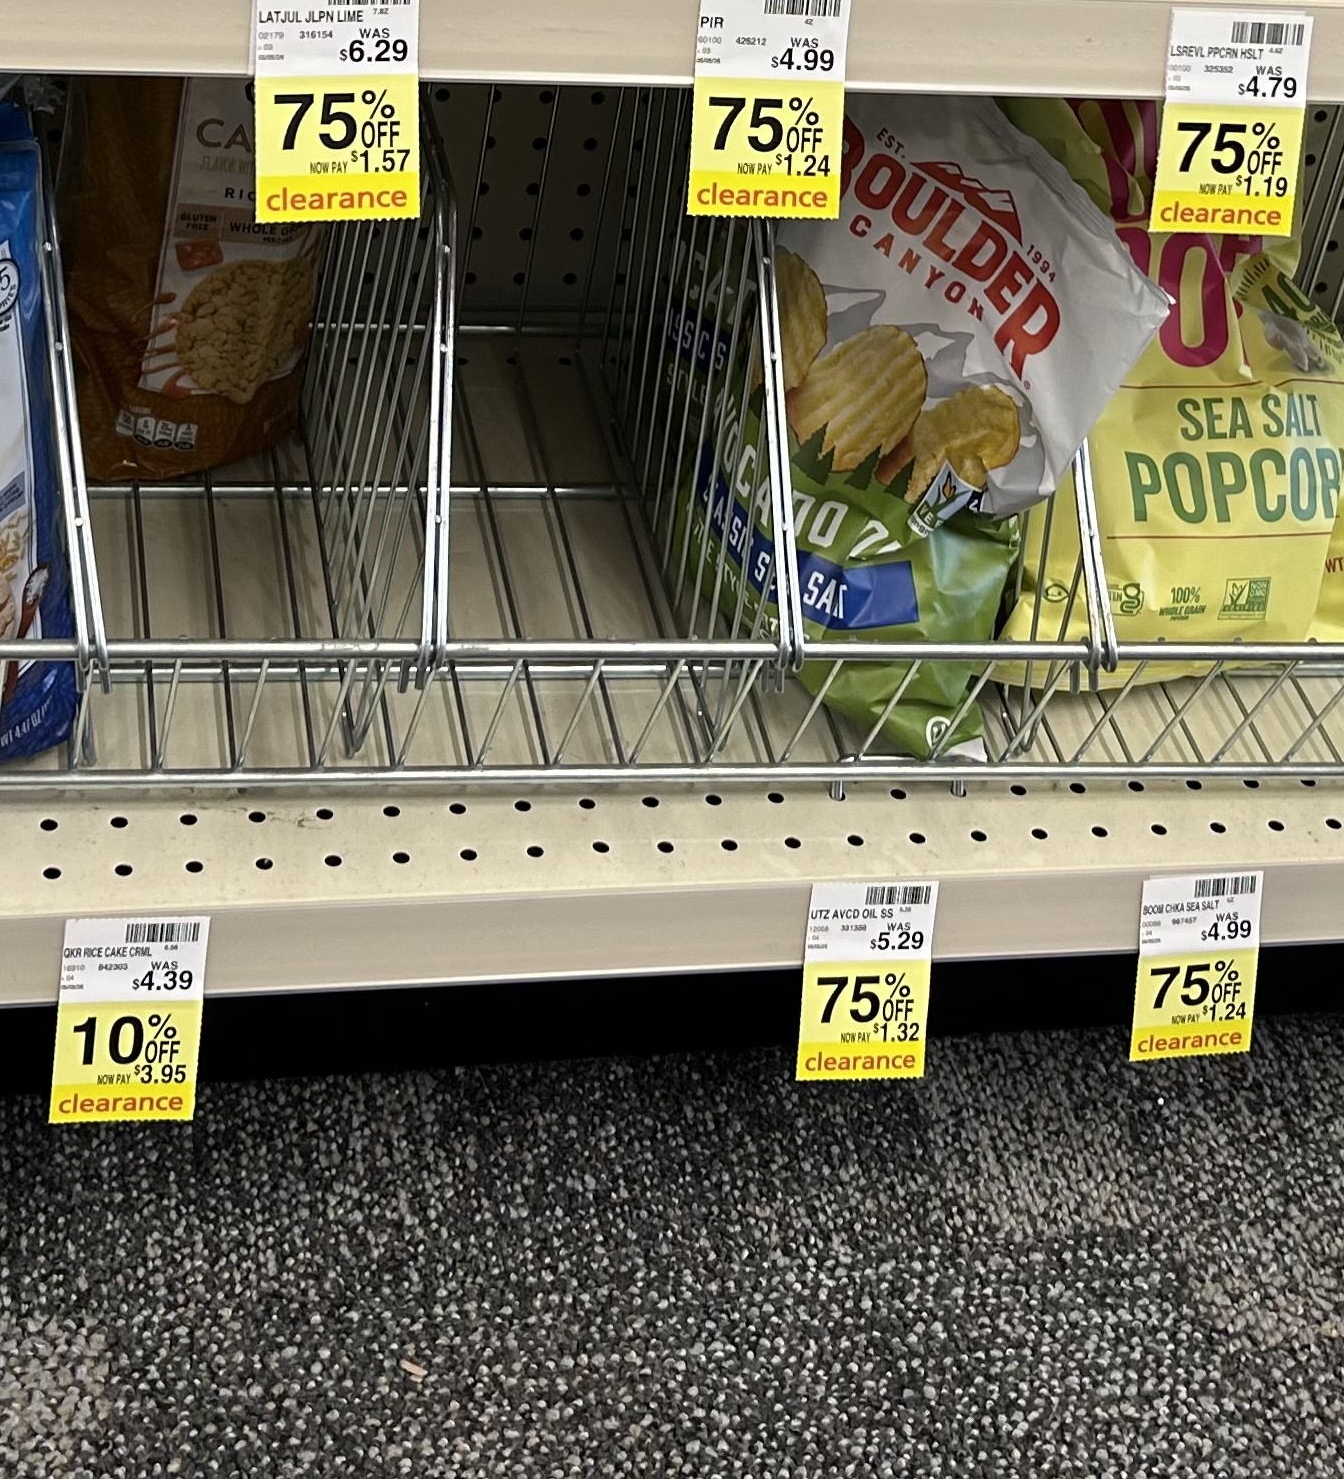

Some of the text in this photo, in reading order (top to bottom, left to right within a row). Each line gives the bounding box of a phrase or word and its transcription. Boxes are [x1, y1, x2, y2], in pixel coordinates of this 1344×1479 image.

[259, 10, 364, 23] LATJUL JLPN LIME
[700, 17, 724, 28] PIR
[339, 39, 408, 62] $6.29
[790, 37, 819, 48] WAS
[771, 48, 834, 72] $4.99
[1256, 66, 1282, 76] WAS
[1238, 76, 1297, 98] $4.79
[1177, 122, 1283, 175] 75% OFF
[697, 183, 827, 207] clearance
[1236, 175, 1288, 197] $1.19
[266, 187, 407, 212] clearance
[1160, 201, 1281, 225] clearance
[229, 222, 277, 236] WHOLE
[849, 214, 985, 322] CANYON
[1177, 393, 1322, 442] SEA SALT
[1170, 586, 1201, 604] 100%
[811, 909, 893, 920] UTZ AVCD OIL SS
[1216, 912, 1239, 921] WAS
[870, 931, 924, 950] $5.29
[1201, 920, 1251, 941] $4.99
[64, 946, 152, 958] QKR RICE CAKE CRML
[132, 971, 193, 991] $4.39
[1203, 1002, 1246, 1022] $1.24
[73, 1013, 181, 1065] 10% OFF
[873, 1023, 919, 1043] $1.32
[1138, 1031, 1242, 1053] clearance
